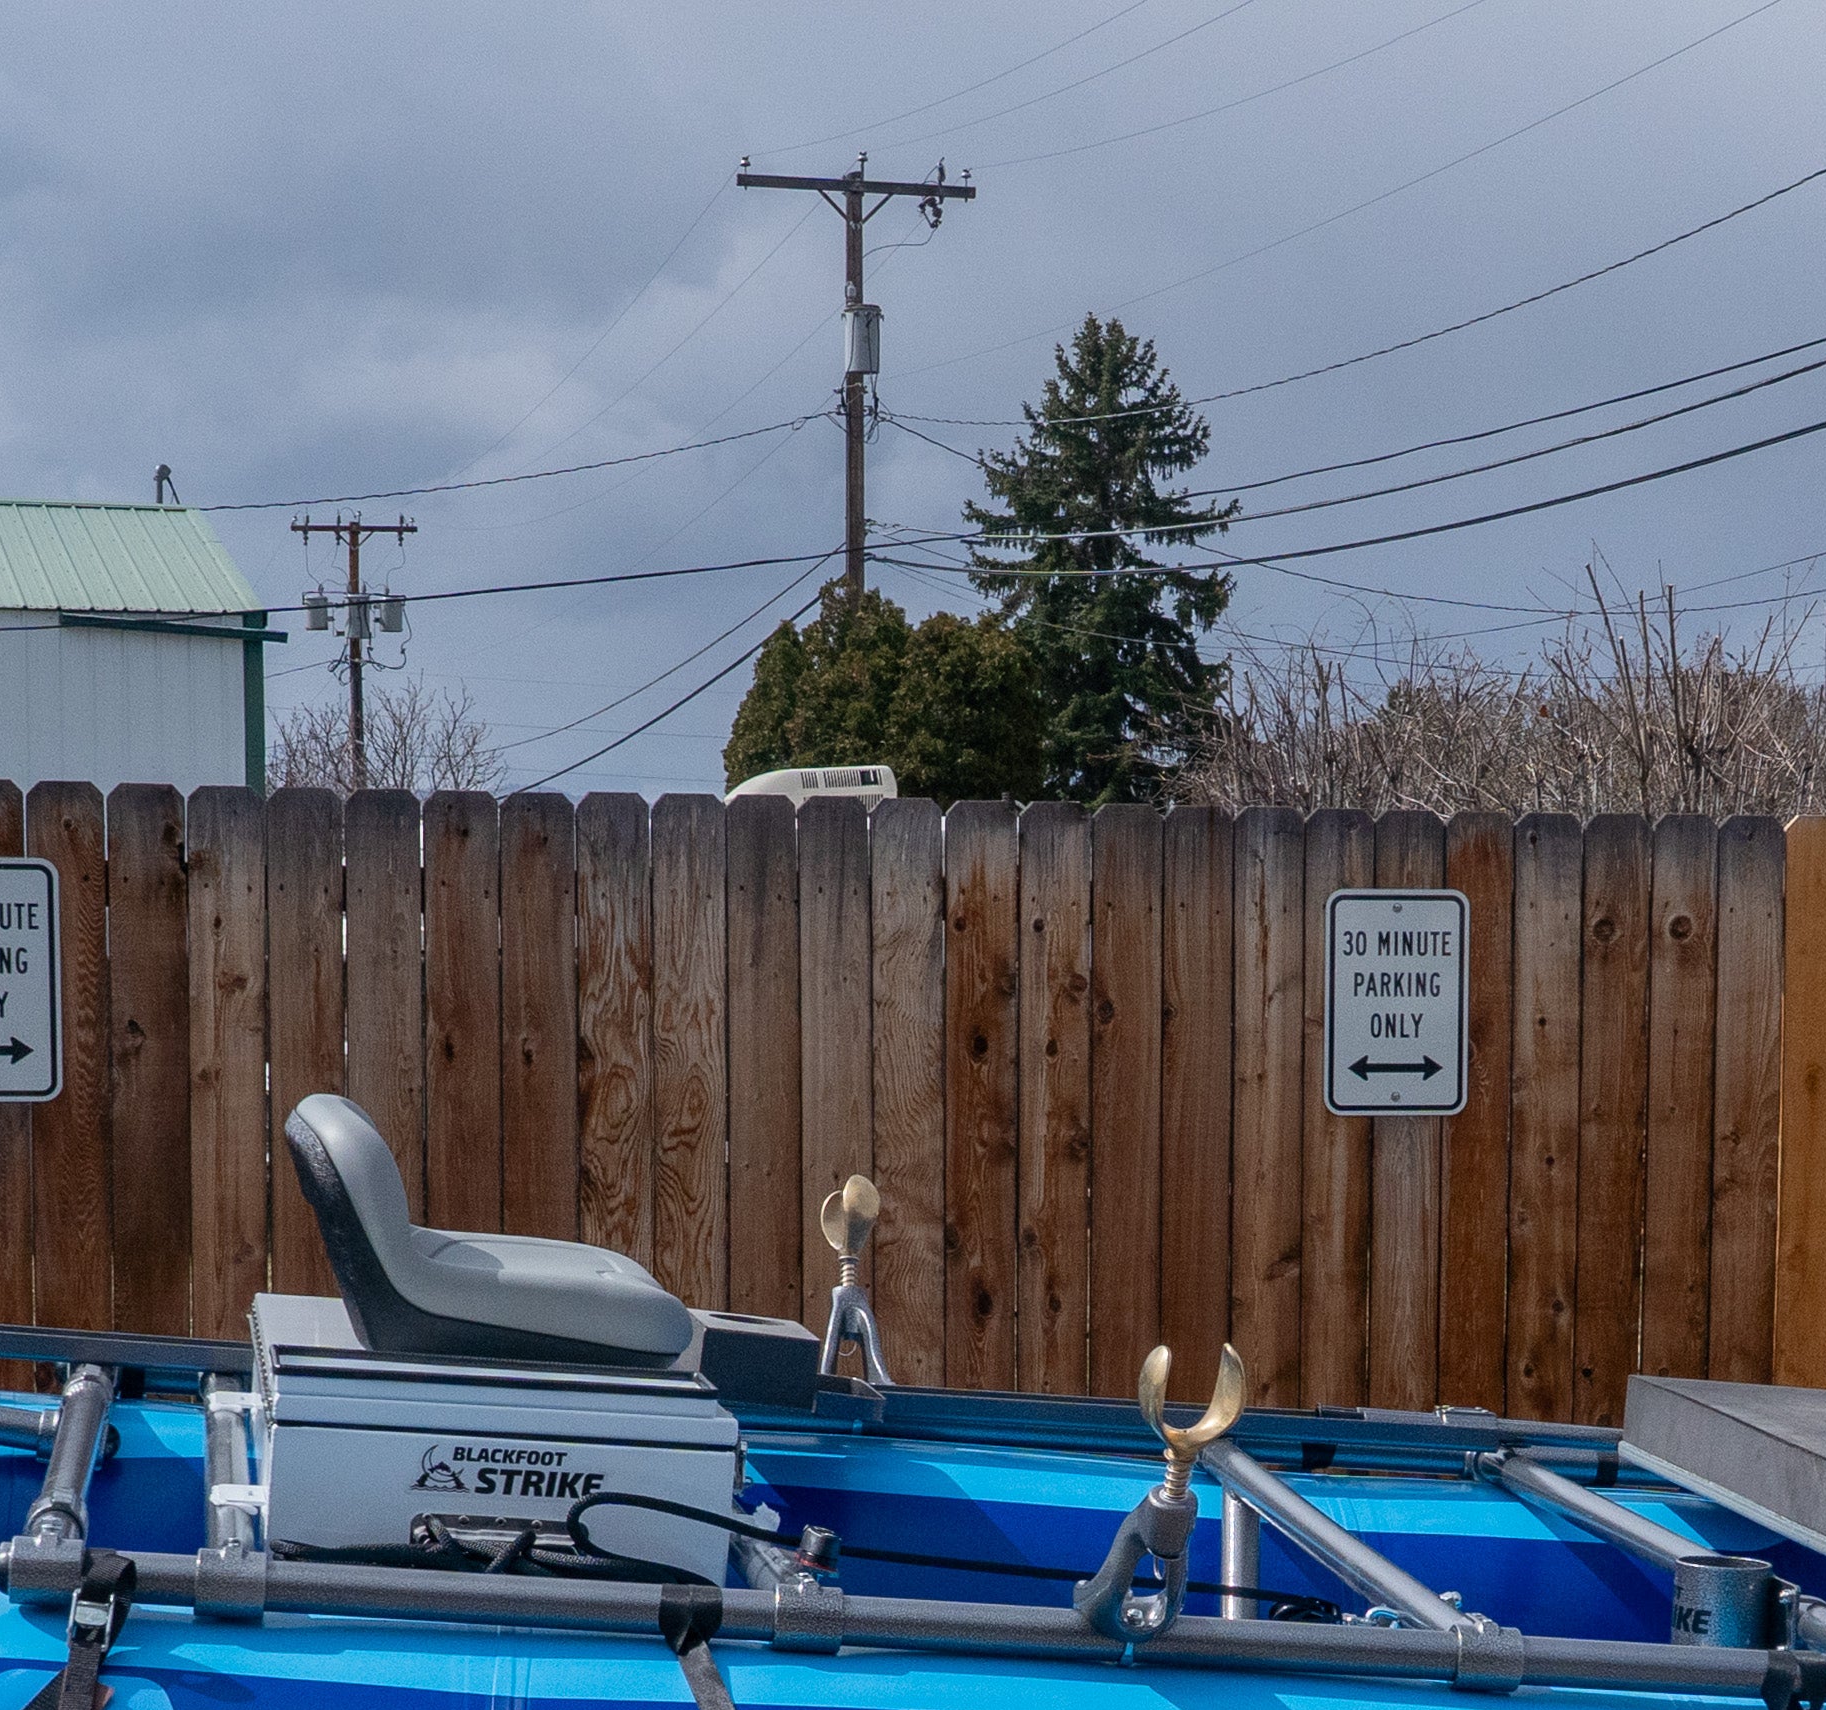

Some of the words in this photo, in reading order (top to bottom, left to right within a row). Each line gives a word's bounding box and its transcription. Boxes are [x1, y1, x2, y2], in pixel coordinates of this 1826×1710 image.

[1342, 930, 1368, 957] 30
[1377, 930, 1453, 957] MINUTE
[1353, 972, 1442, 998] PARKING
[1369, 1012, 1424, 1039] ONLY
[452, 1445, 569, 1467] BLACKFOOT
[473, 1467, 606, 1500] STRIKE
